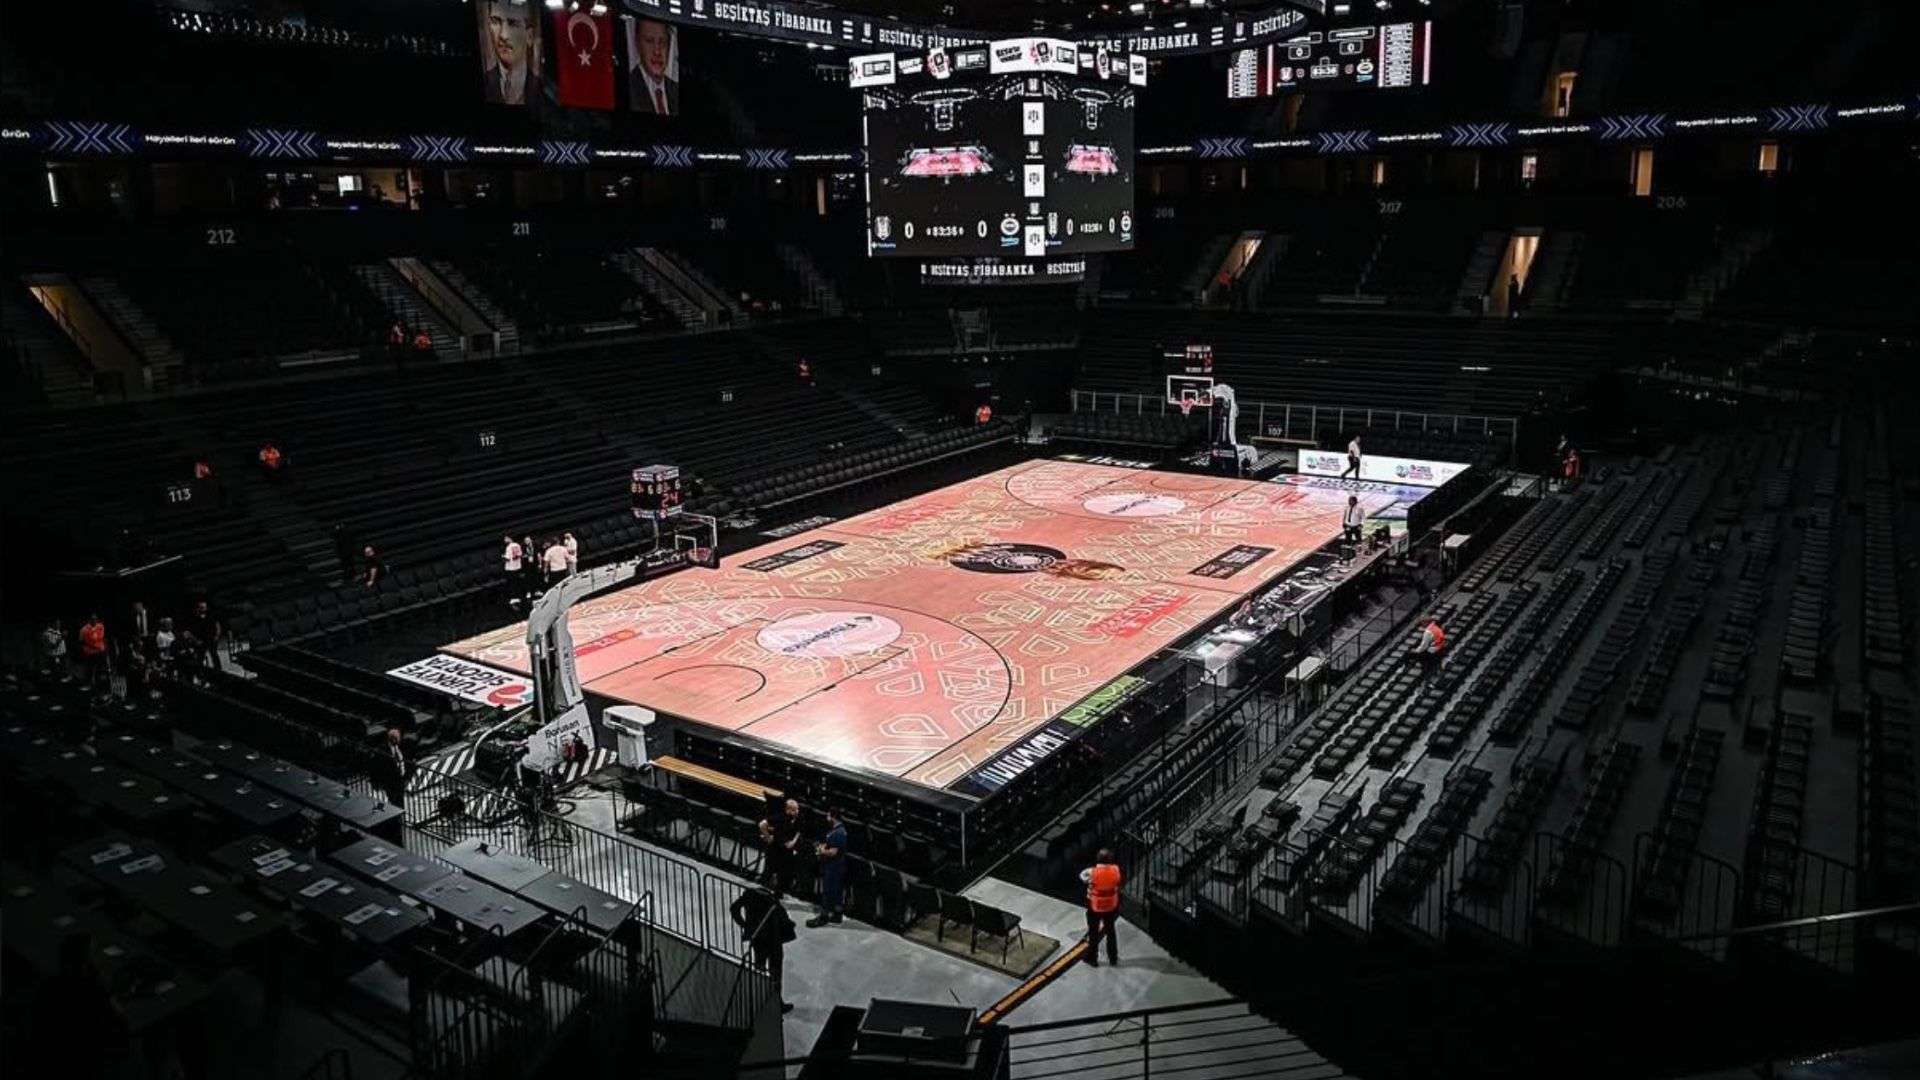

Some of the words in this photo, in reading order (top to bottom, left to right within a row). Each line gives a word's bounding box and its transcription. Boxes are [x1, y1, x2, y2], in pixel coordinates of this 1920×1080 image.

[715, 2, 771, 26] BEŞİKTAŞ
[775, 10, 833, 35] FİBABANKA
[1128, 33, 1199, 51] FİBABANKA
[206, 229, 237, 244] 212
[512, 221, 530, 236] 211
[904, 221, 914, 239] 0
[978, 220, 988, 238] 0
[480, 436, 496, 447] 112
[168, 488, 192, 503] 113
[661, 491, 679, 508] 24
[544, 720, 580, 739] Borusan
